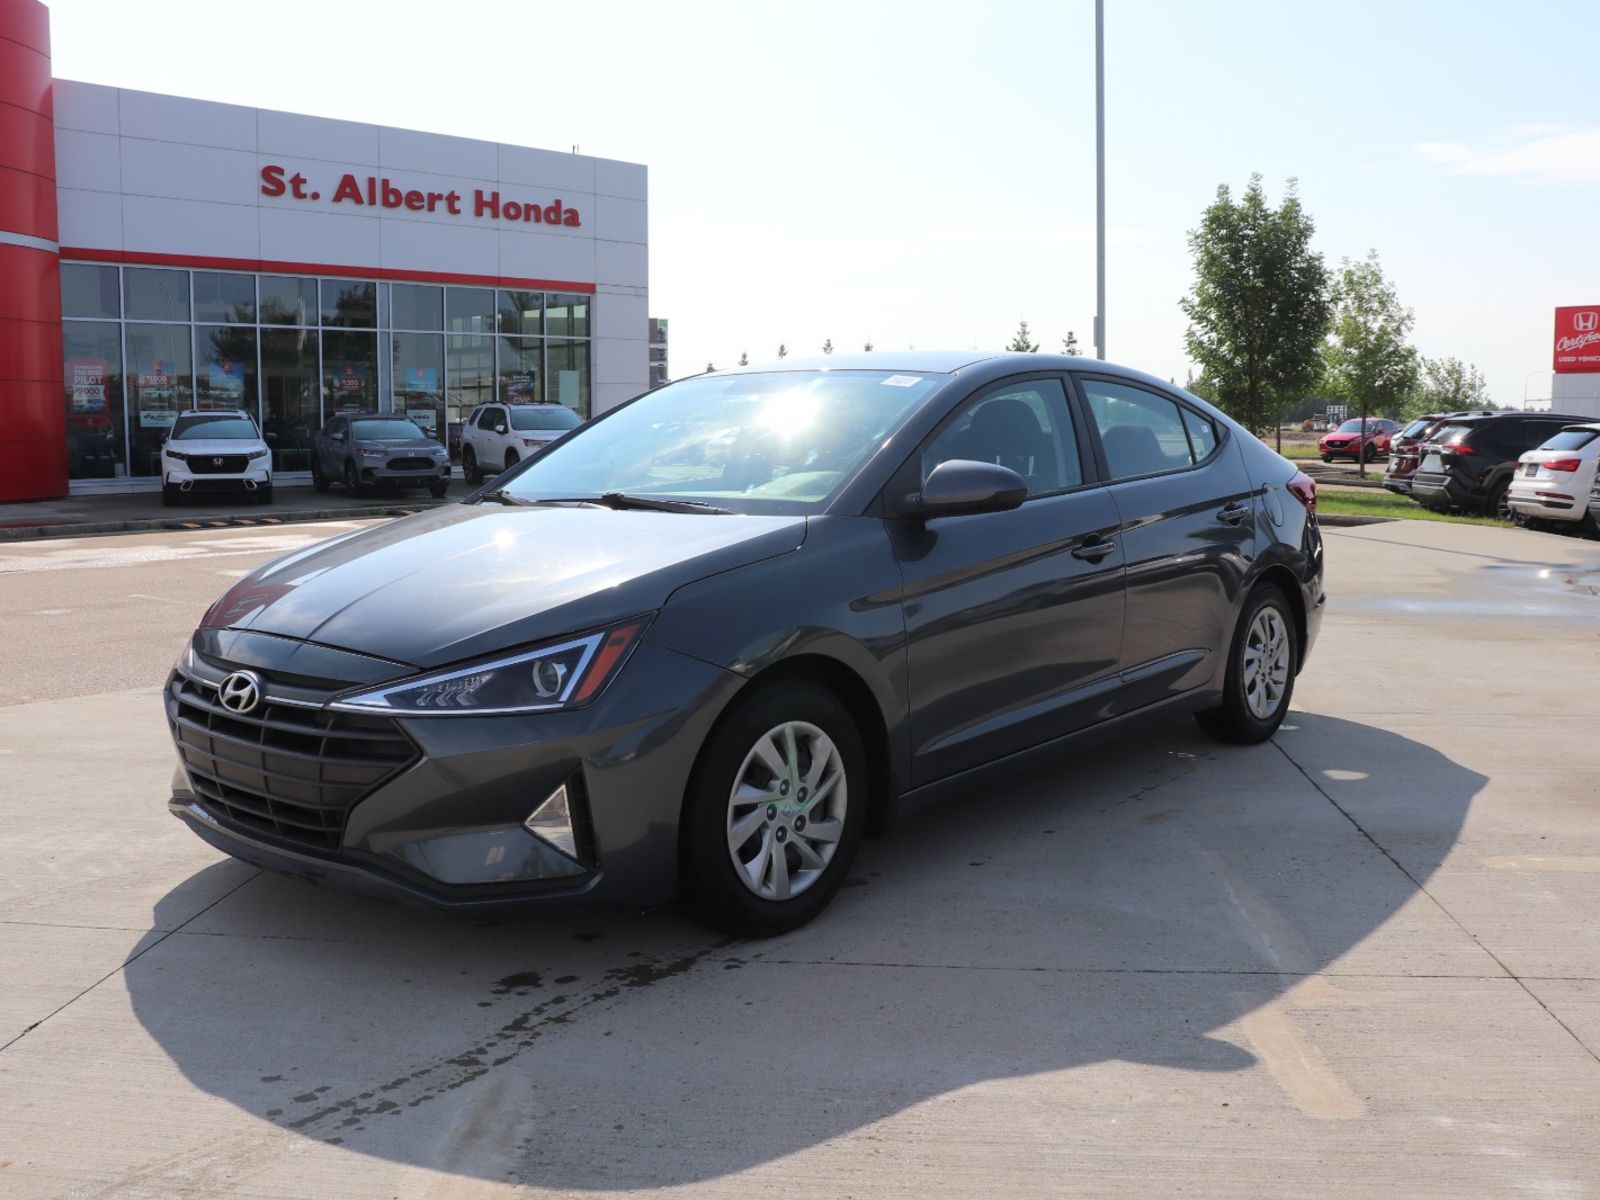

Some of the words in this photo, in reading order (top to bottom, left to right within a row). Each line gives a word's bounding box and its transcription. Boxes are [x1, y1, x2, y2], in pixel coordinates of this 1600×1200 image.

[261, 165, 321, 200] St.
[332, 174, 462, 215] Albert
[474, 189, 582, 227] Honda
[74, 376, 103, 384] PILOT
